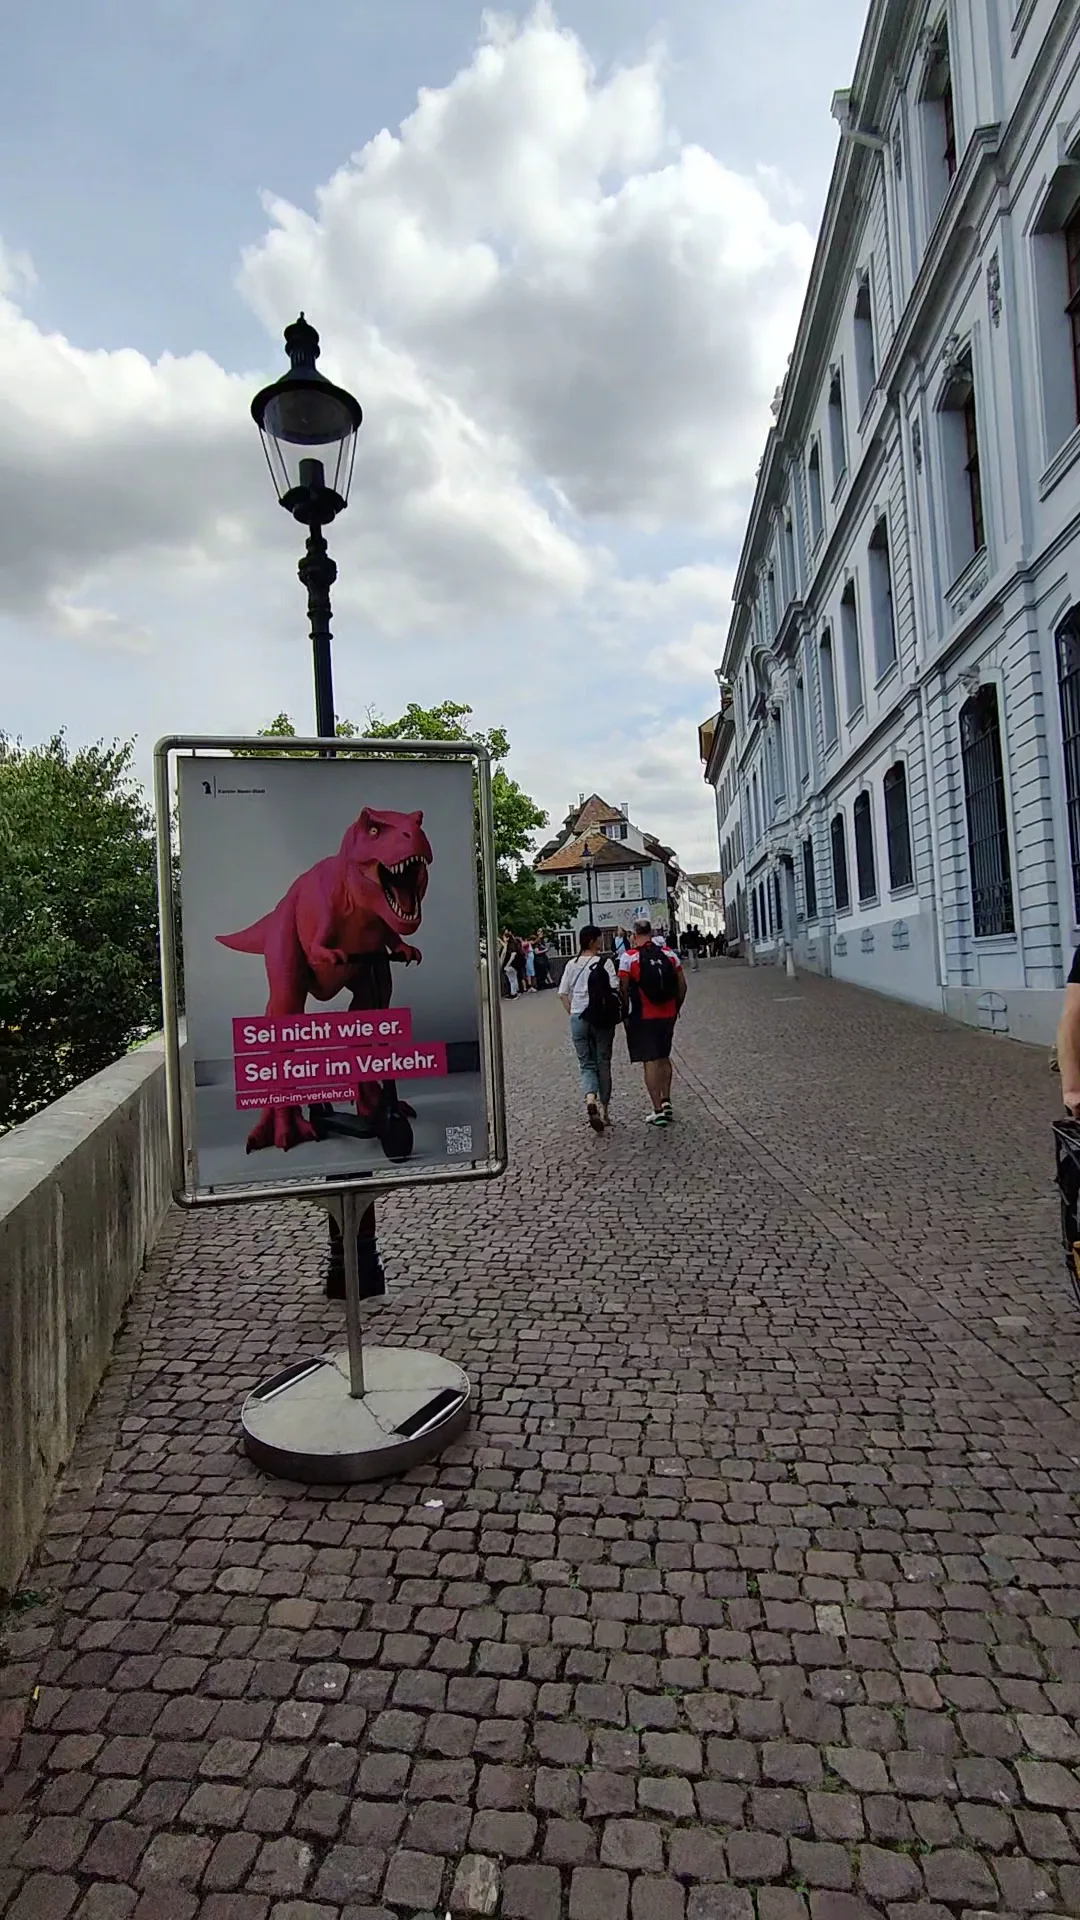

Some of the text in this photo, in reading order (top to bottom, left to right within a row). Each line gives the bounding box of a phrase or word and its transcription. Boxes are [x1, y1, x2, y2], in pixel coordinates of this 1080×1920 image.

[243, 1019, 403, 1045] Sei nicht wie er.
[244, 1051, 439, 1082] Sei fair im Verkehr.
[240, 1087, 356, 1107] www.fair-im-verkehr.ch
